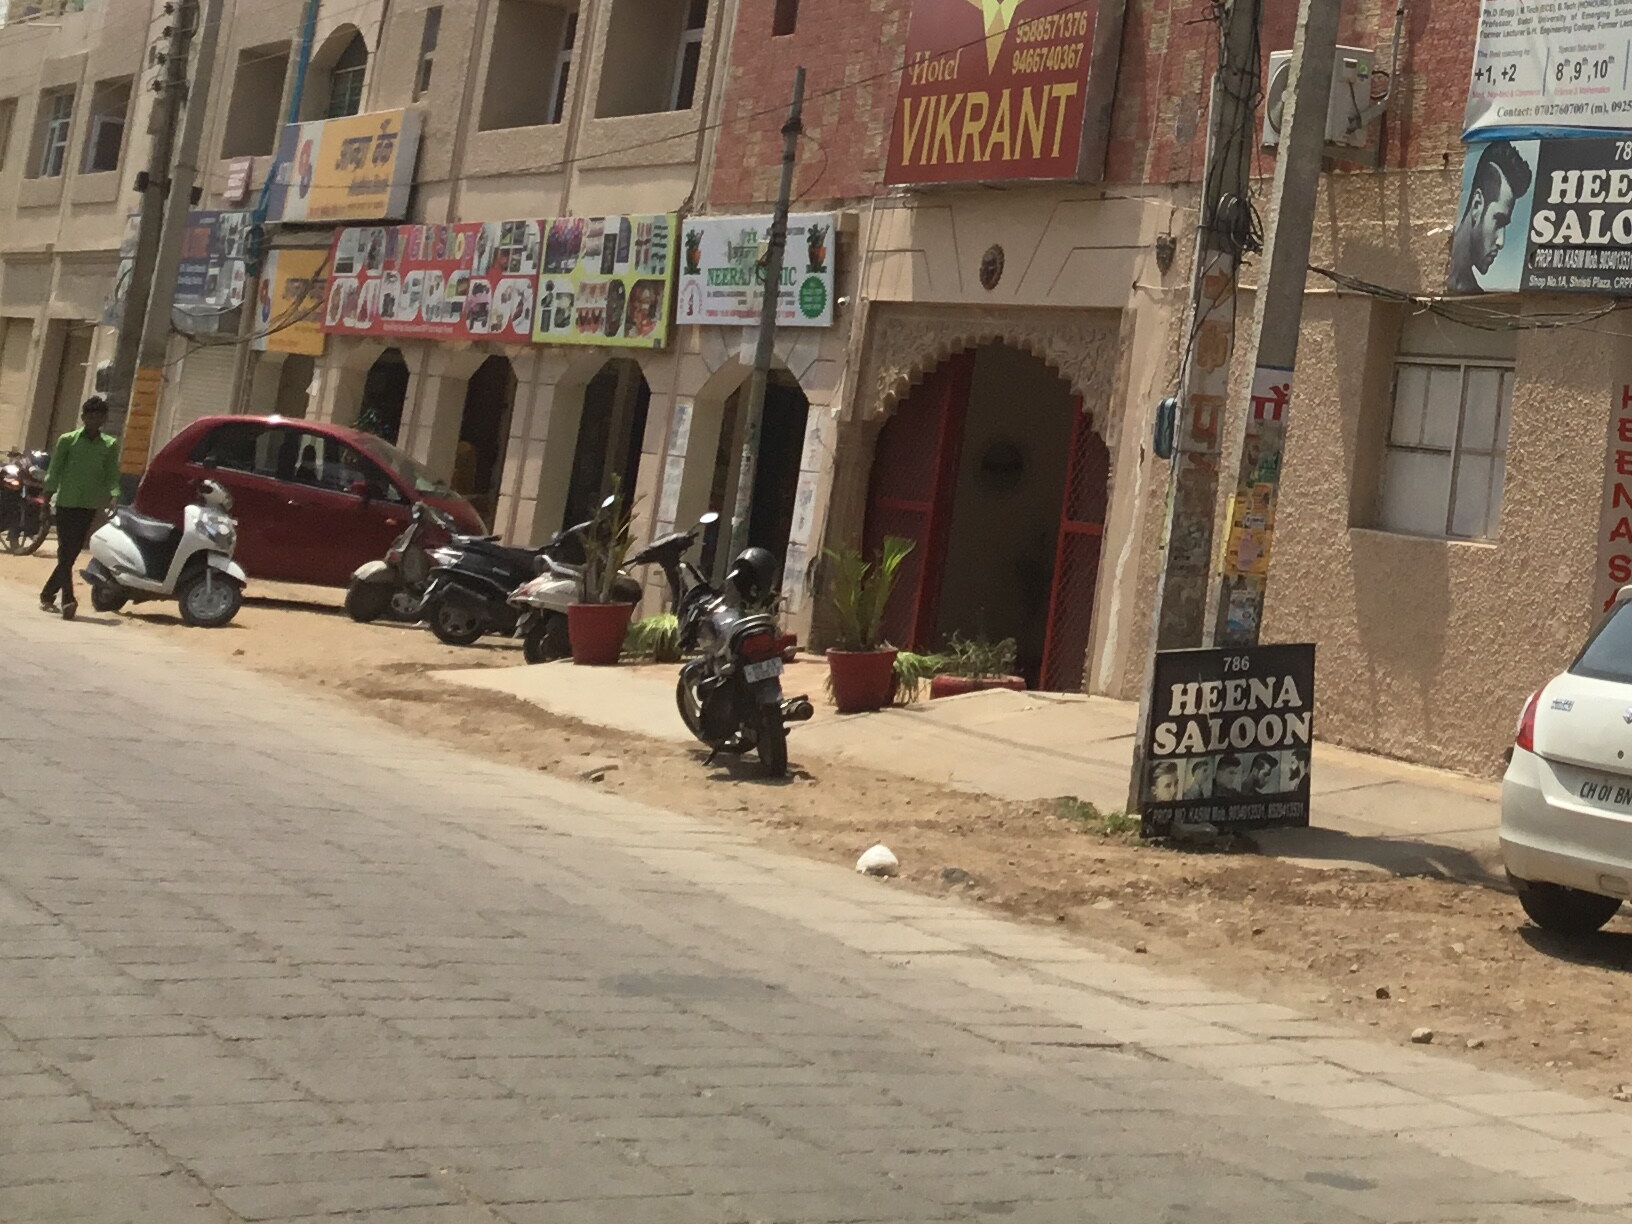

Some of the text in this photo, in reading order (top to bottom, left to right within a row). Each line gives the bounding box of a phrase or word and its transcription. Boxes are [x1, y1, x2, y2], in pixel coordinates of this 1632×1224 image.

[1016, 10, 1088, 44] 9588571376
[1571, 12, 1577, 20] of
[909, 47, 964, 86] Hotel
[1012, 43, 1084, 75] 9466740367
[1475, 64, 1517, 86] +1, +2
[1497, 106, 1532, 118] Contact:
[1534, 103, 1589, 116] 07027607007
[901, 80, 1078, 166] VIKRANT
[706, 267, 754, 286] NEERAJ
[1529, 275, 1546, 288] Shop
[1224, 656, 1250, 672] 786
[1168, 675, 1302, 716] HEENA
[1153, 711, 1312, 756] SALOON
[1580, 781, 1597, 800] CH
[1598, 786, 1612, 803] 01
